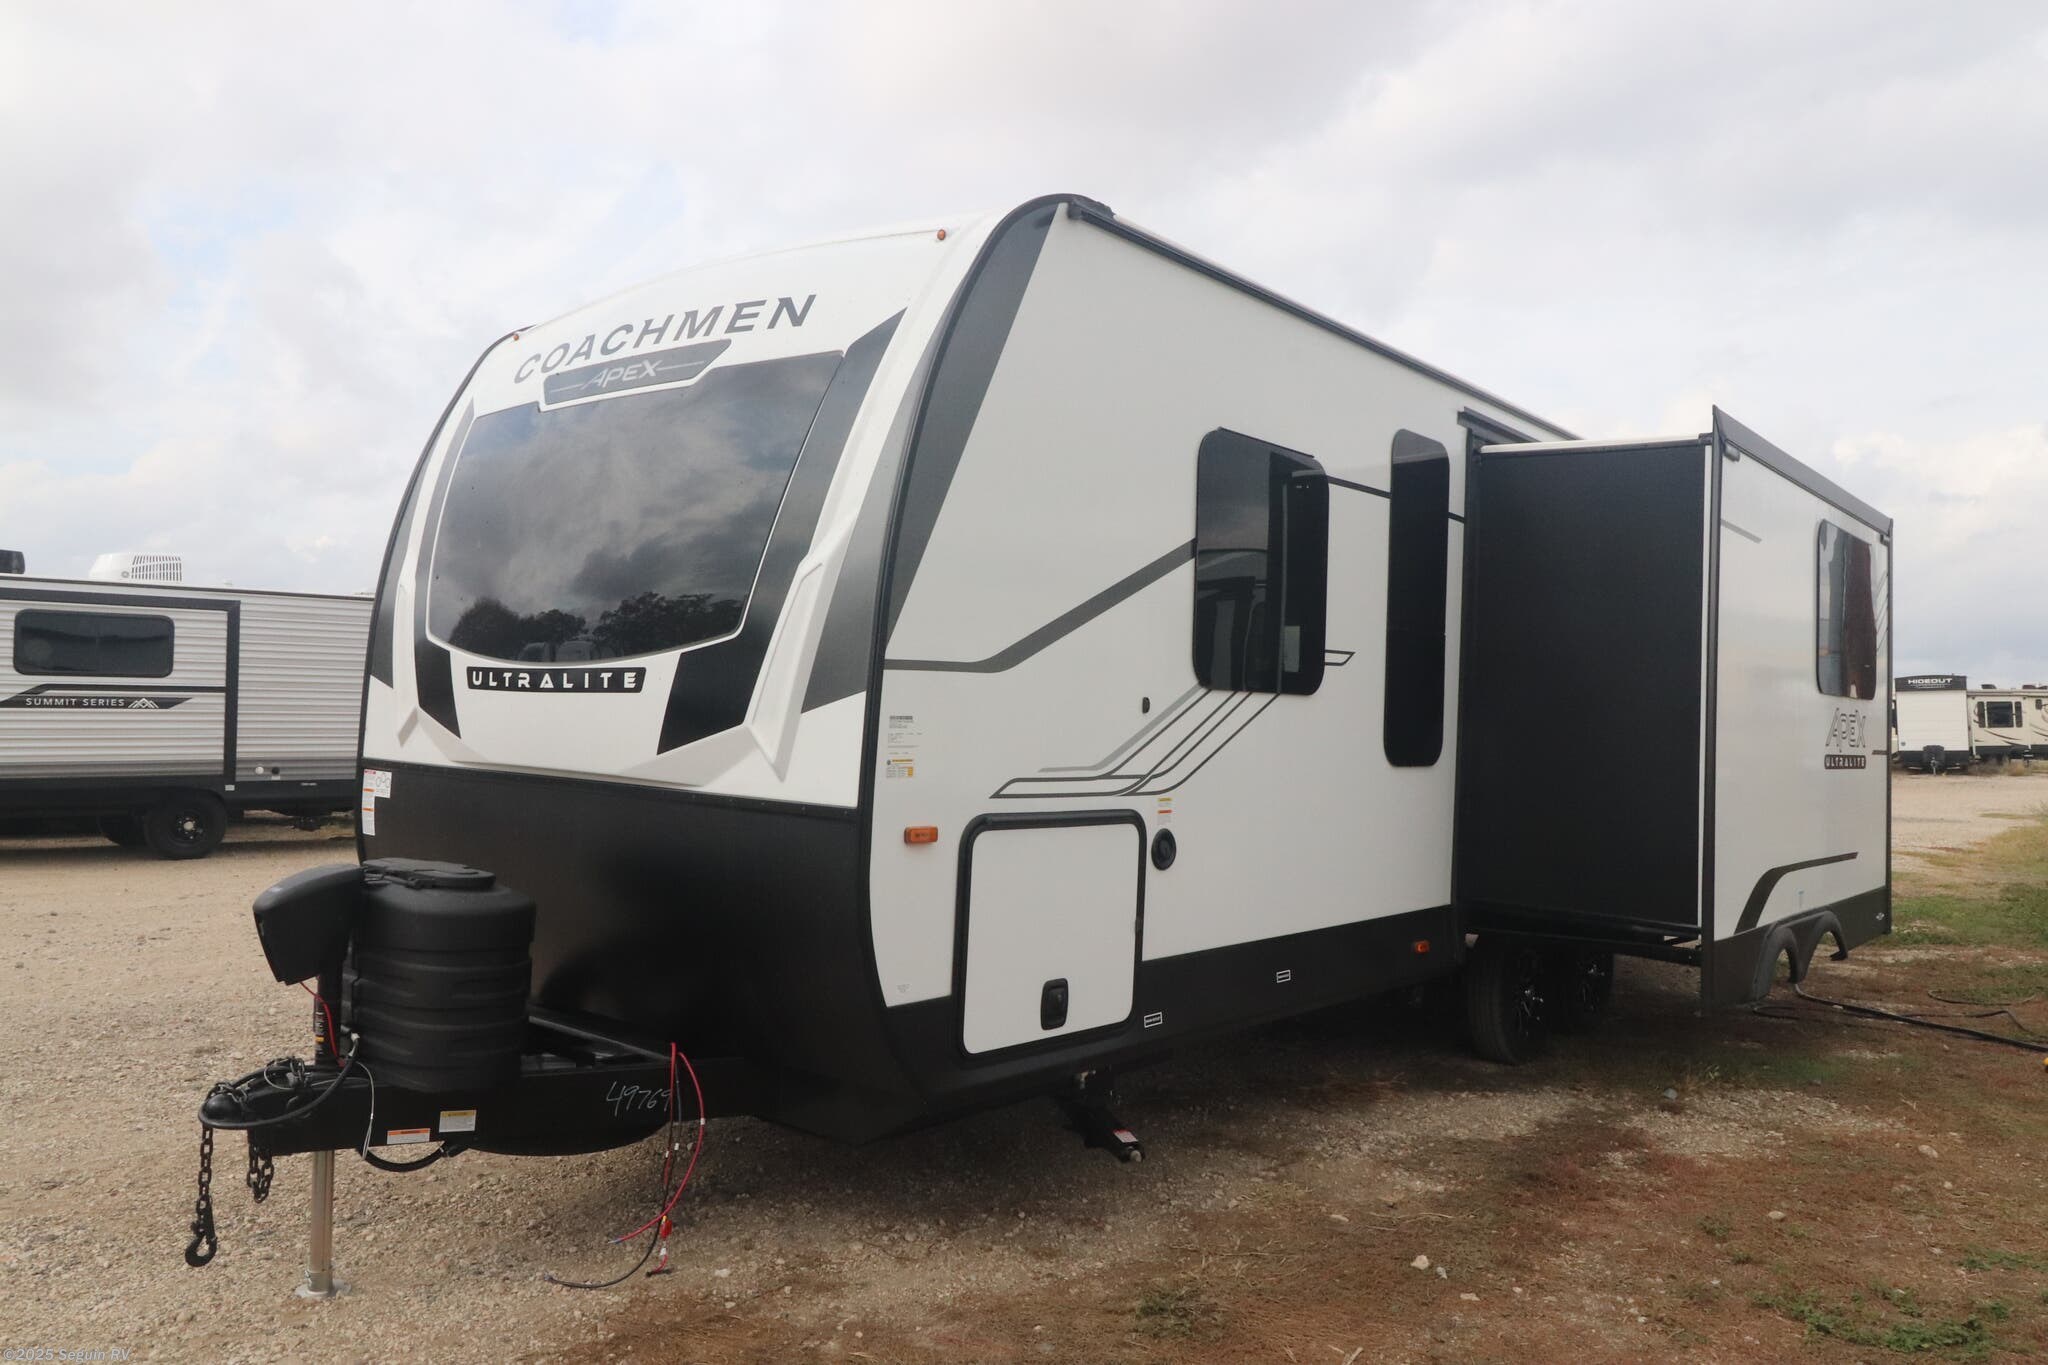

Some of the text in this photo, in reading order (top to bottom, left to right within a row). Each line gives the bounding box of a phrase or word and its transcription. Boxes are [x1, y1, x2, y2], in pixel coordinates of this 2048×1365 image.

[514, 294, 816, 384] COACHMEN
[582, 359, 663, 389] APEX
[472, 671, 637, 689] ULTRALITE
[25, 697, 125, 707] SUMMIT SERIES
